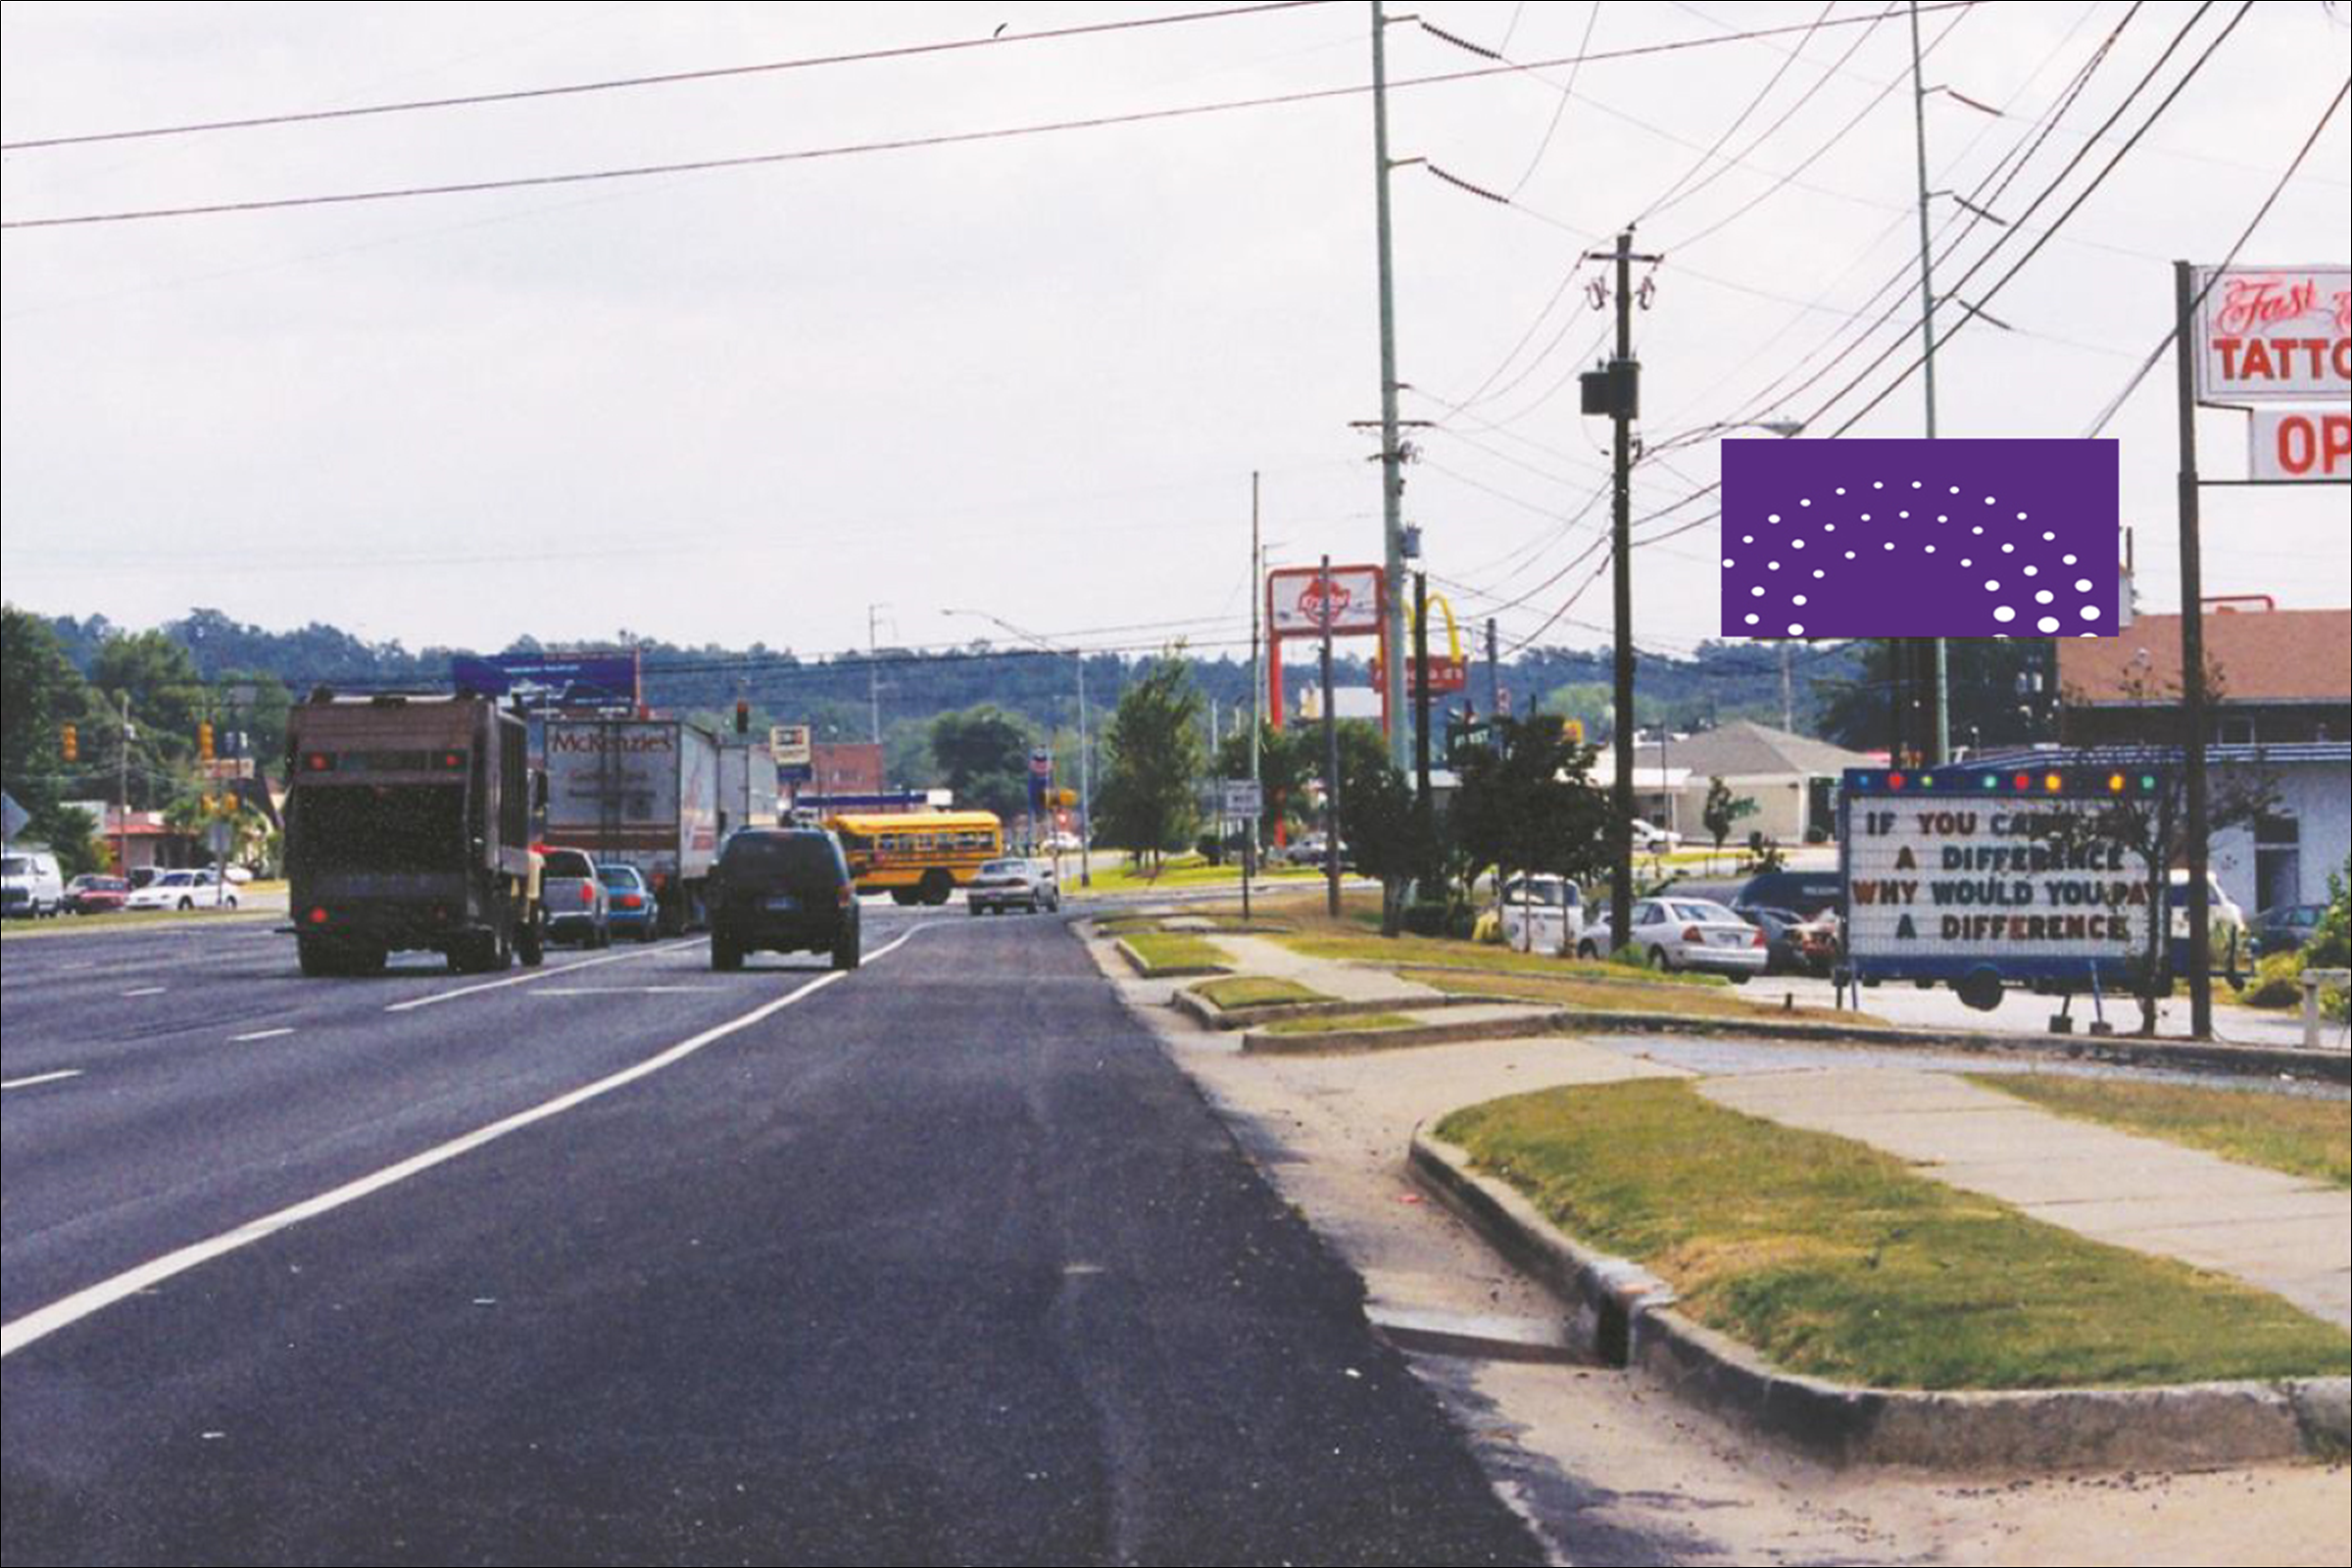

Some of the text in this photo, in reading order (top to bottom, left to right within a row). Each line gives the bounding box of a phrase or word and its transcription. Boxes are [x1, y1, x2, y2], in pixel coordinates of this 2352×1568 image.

[2217, 278, 2316, 335] Fast
[2278, 415, 2350, 475] OP
[1867, 811, 1896, 836] IF
[1917, 811, 1977, 836] YOU
[1895, 846, 1916, 870] A
[1851, 879, 1918, 906] WHY
[1931, 879, 2033, 906] WOULD
[2045, 880, 2101, 906] YOU
[1895, 913, 2127, 940] A DIFFERENCE
